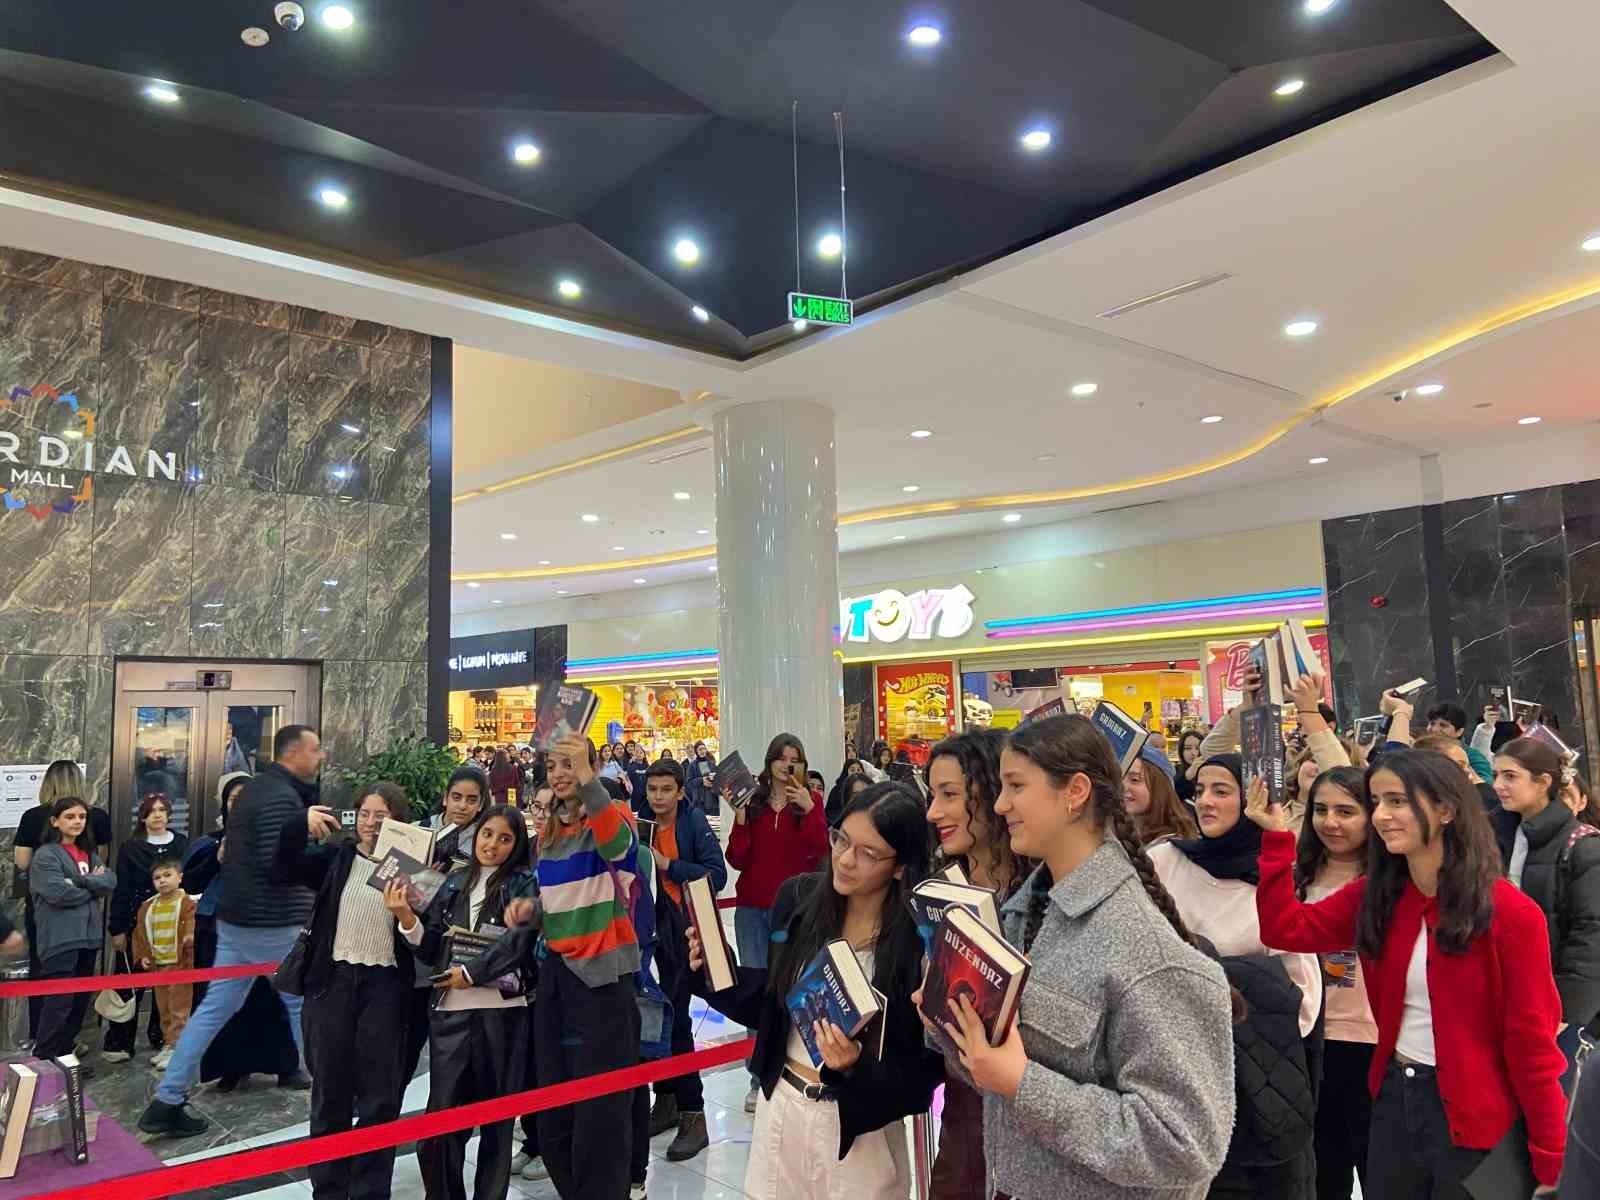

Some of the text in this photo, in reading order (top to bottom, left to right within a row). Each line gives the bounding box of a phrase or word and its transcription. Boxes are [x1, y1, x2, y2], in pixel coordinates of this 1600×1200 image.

[825, 301, 849, 314] EXIT
[0, 432, 177, 481] RDIAN
[10, 468, 74, 489] MALL
[944, 929, 1004, 990] DÜZENBAZ
[823, 963, 852, 1017] CAMBAZ
